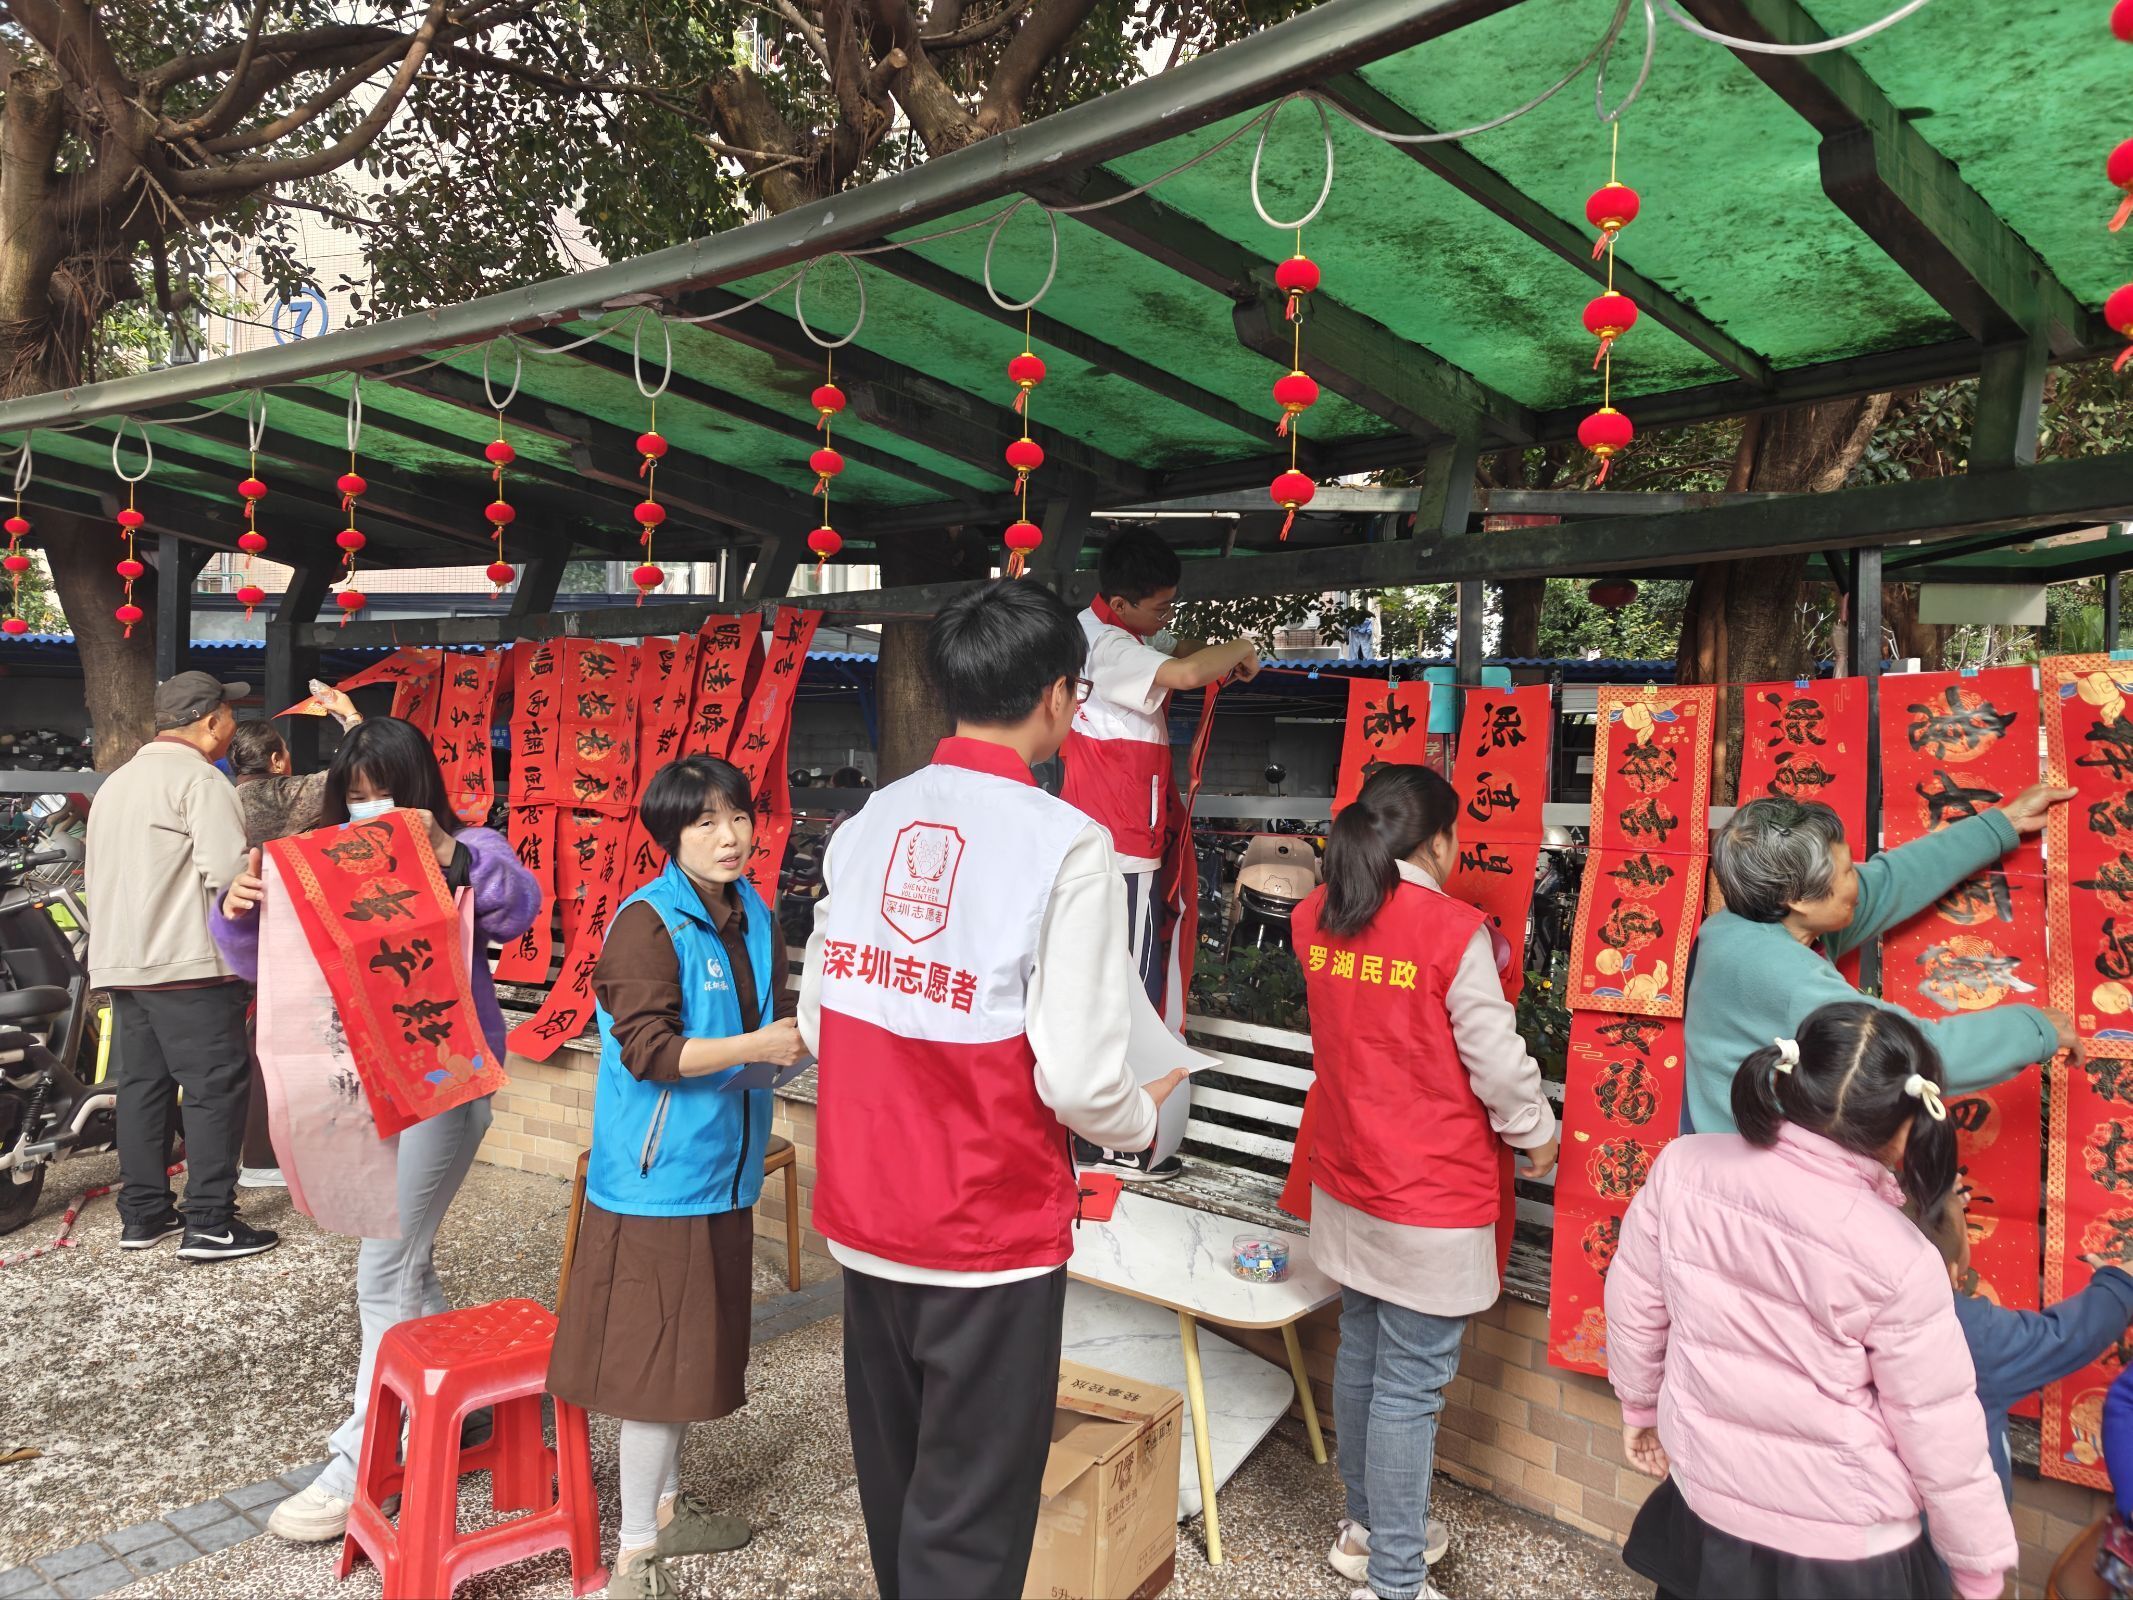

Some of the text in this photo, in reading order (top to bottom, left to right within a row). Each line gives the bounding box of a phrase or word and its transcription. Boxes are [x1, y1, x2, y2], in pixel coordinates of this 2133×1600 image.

[289, 301, 313, 340] 7
[900, 890, 939, 903] VOLUNTEER
[903, 882, 940, 895] SHENZHEN
[886, 899, 943, 924] 深圳志愿者
[822, 938, 978, 1015] 深圳志愿者
[1308, 945, 1419, 990] 罗湖民政
[1070, 1376, 1143, 1403] 轻拿轻放
